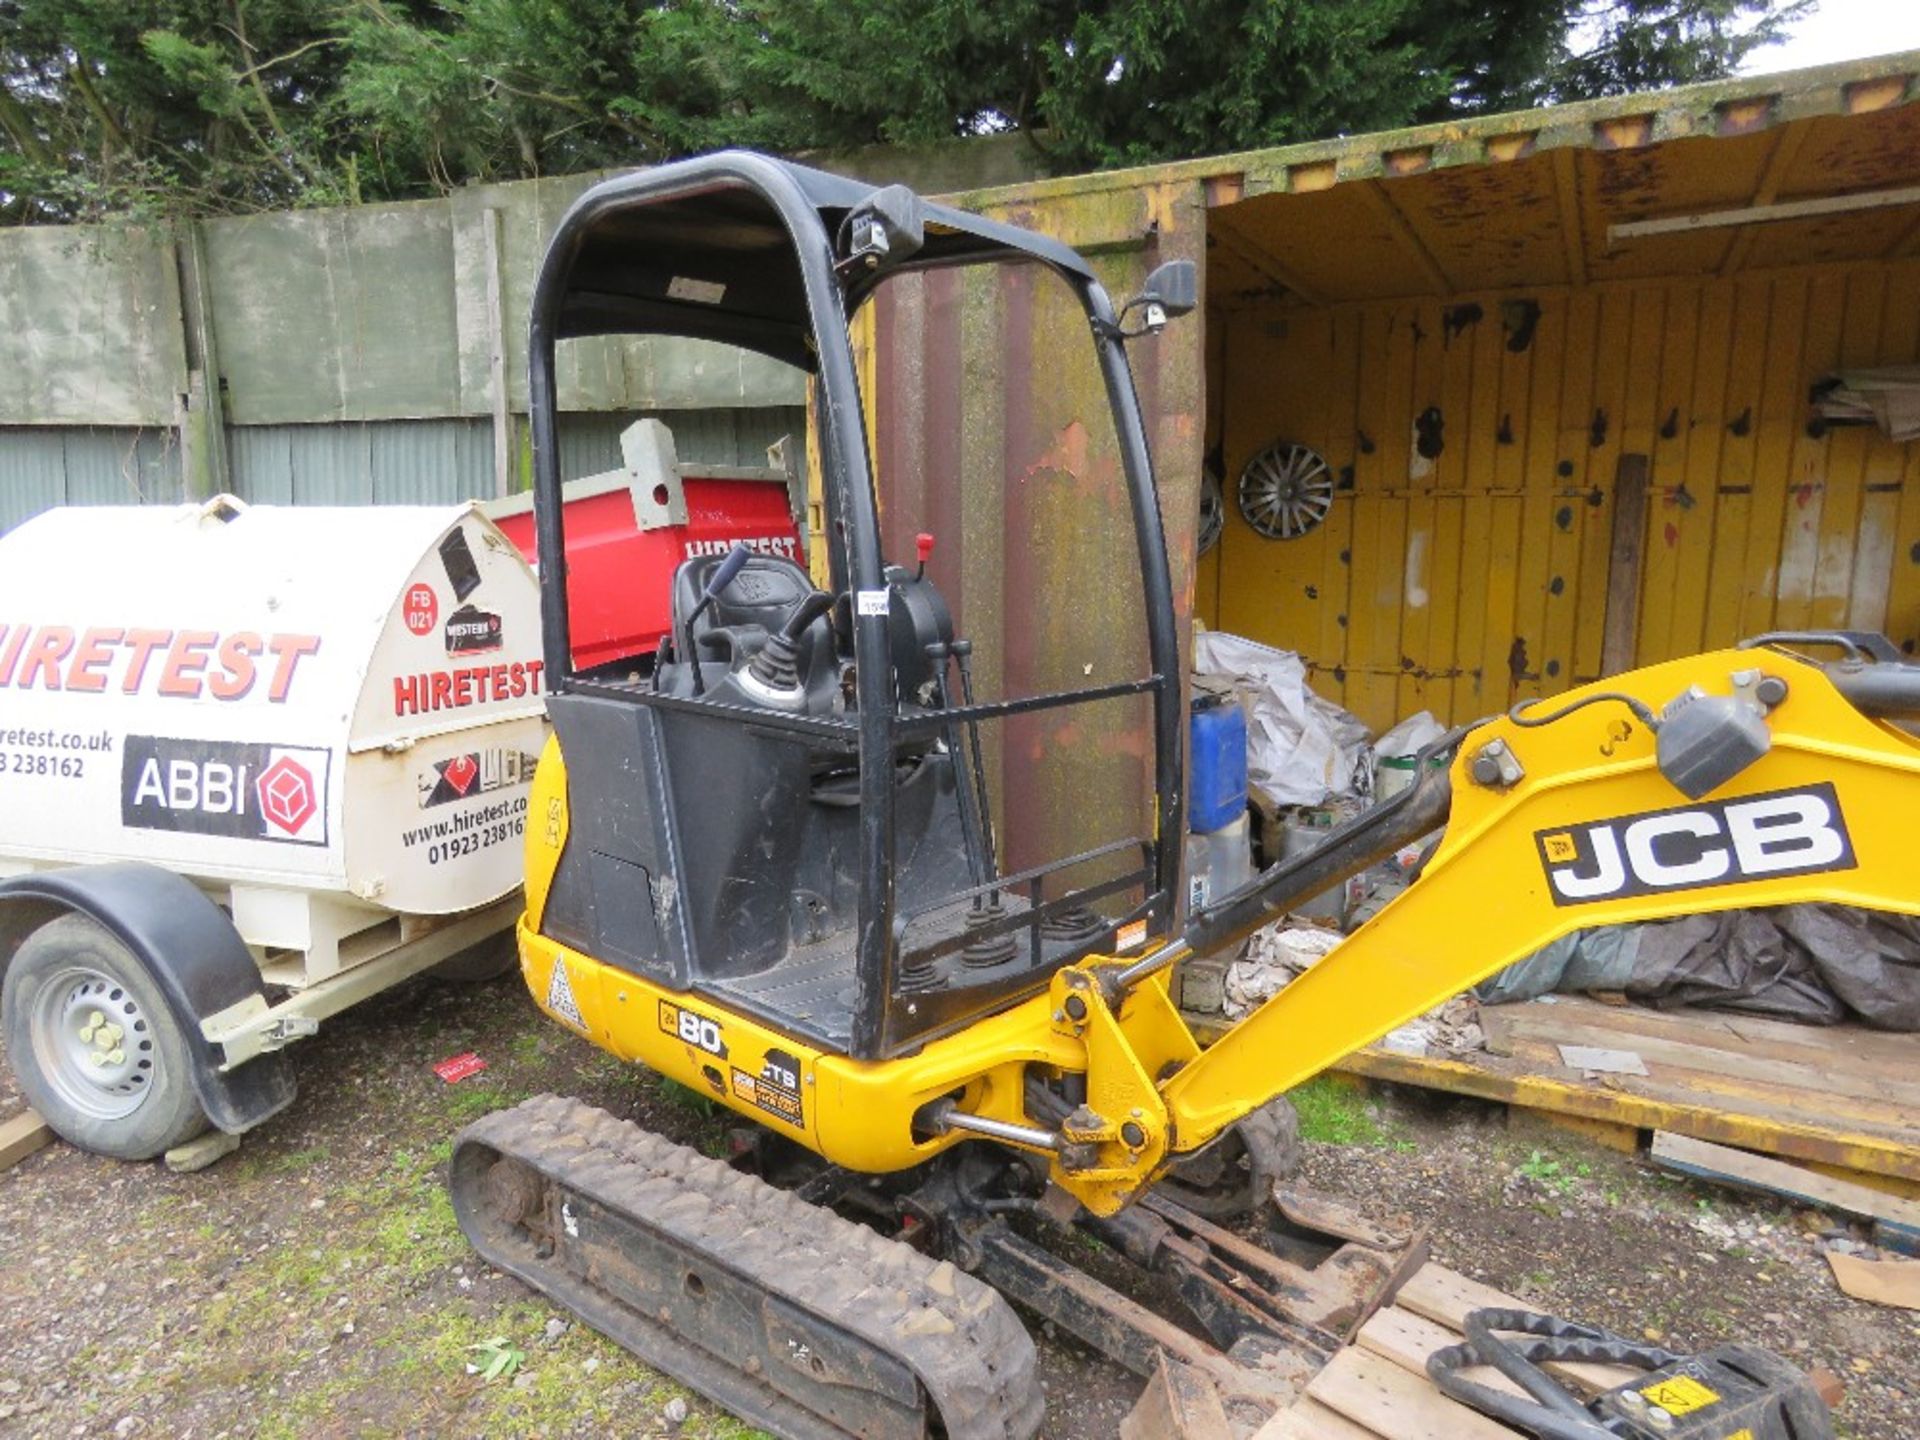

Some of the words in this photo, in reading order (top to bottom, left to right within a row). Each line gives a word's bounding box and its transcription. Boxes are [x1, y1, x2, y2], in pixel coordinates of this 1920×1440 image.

[410, 611, 432, 629] 021
[411, 591, 431, 608] FB
[0, 624, 321, 704] IRETEST
[393, 660, 545, 716] HIRETEST
[13, 754, 84, 778] 238162
[134, 758, 246, 815] ABBI
[429, 833, 479, 865] 01923
[483, 815, 527, 848] 23816
[1552, 794, 1844, 898] JCB
[679, 1011, 721, 1053] 80
